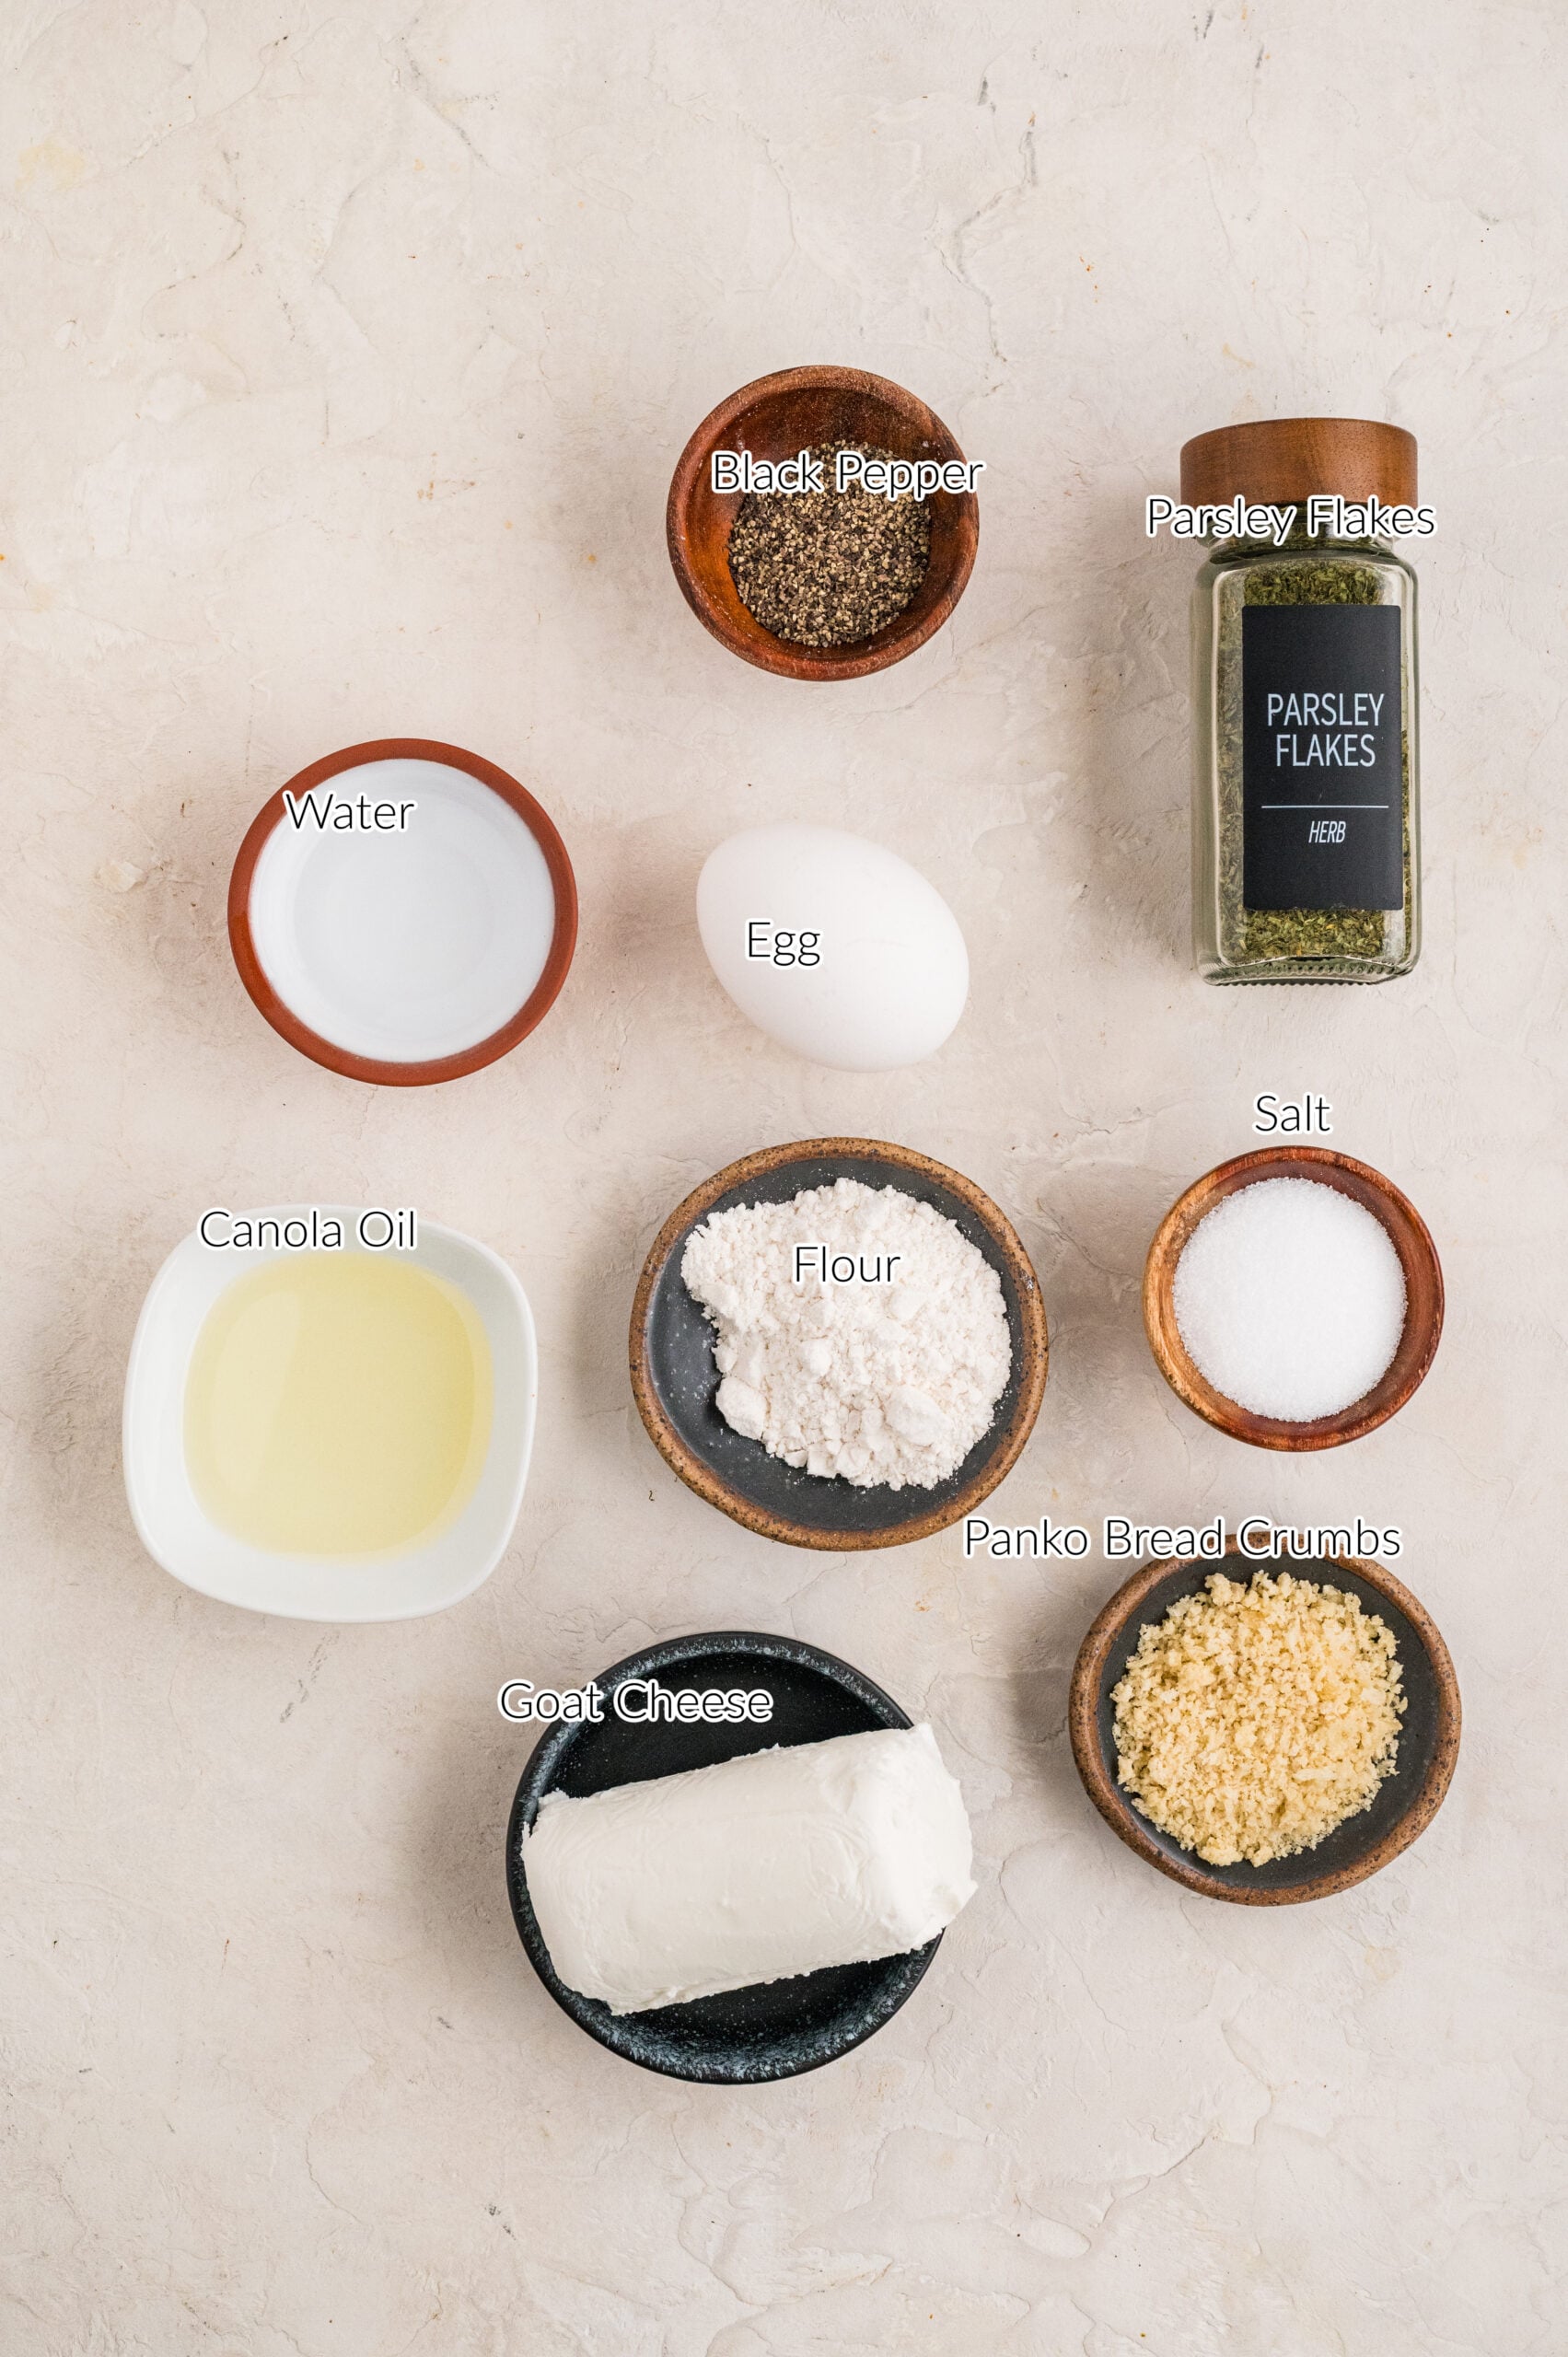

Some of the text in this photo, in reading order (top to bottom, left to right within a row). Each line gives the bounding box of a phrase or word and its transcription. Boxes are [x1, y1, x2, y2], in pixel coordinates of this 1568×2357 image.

[1266, 691, 1385, 727] PARSLEY
[1275, 733, 1376, 768] FLAKES
[1307, 819, 1347, 844] HERB
